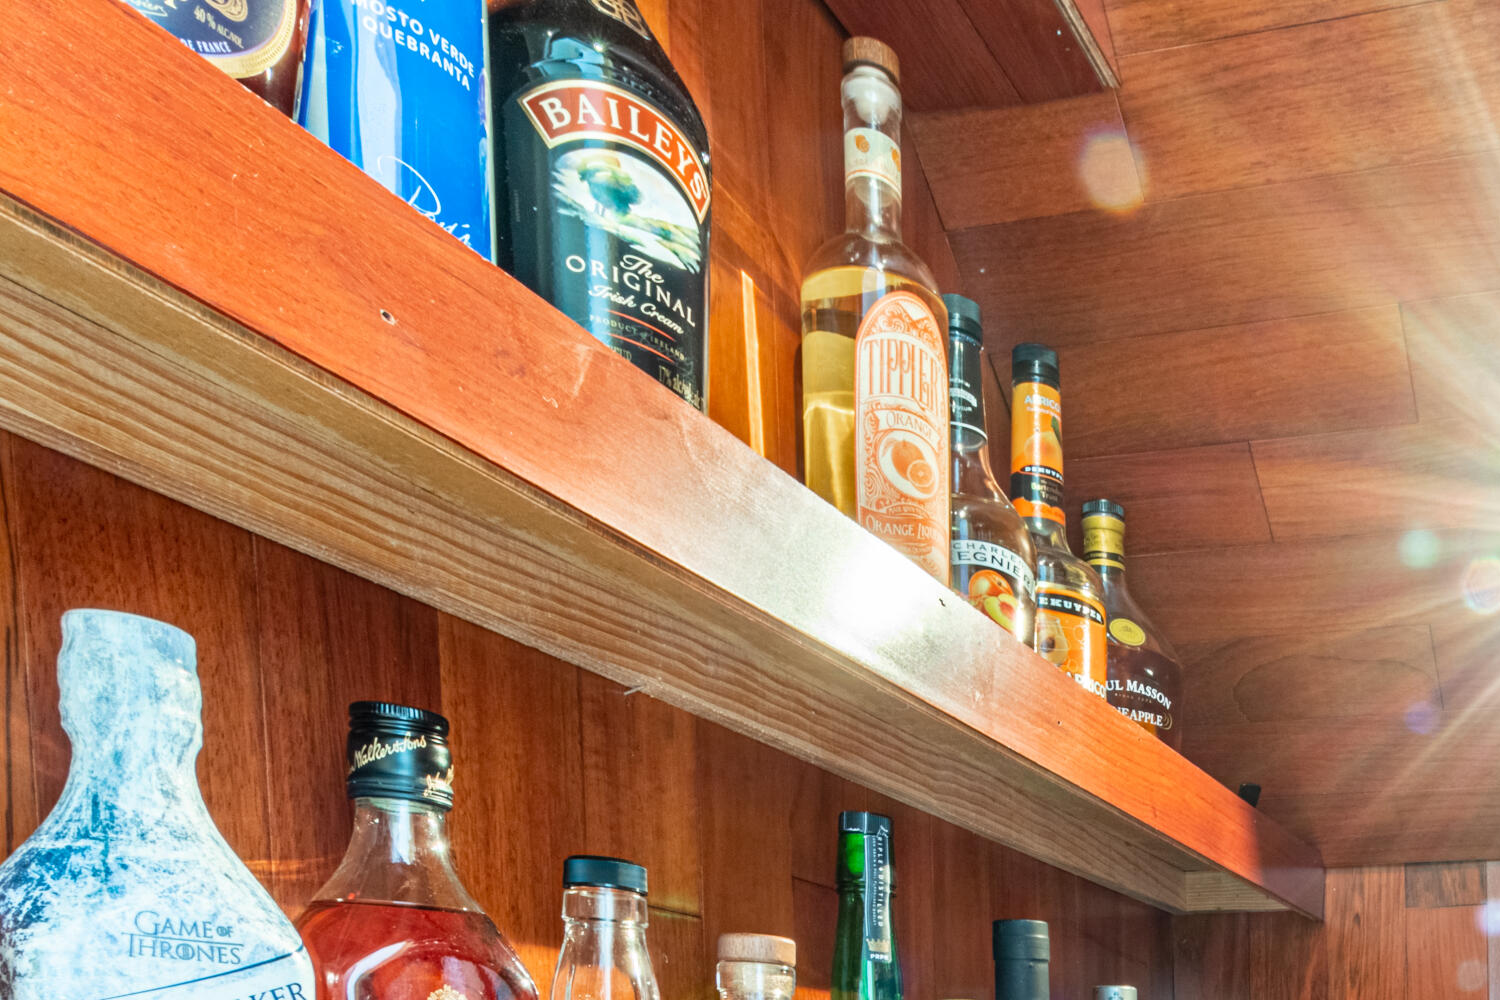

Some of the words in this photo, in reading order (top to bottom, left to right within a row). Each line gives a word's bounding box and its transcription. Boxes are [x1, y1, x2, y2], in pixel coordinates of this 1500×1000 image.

[195, 40, 232, 53] FRANCE
[352, 0, 424, 36] MOSTO
[428, 28, 475, 78] VERDE
[362, 16, 470, 91] QUEBRANTA
[539, 93, 707, 200] BAILEYS
[620, 254, 665, 284] The
[565, 255, 696, 327] ORIGINAL
[640, 303, 684, 334] Cream
[1039, 596, 1102, 622] EKUYPER
[1127, 680, 1172, 710] MASSON
[134, 911, 214, 938] GAME
[128, 934, 241, 965] THRONES
